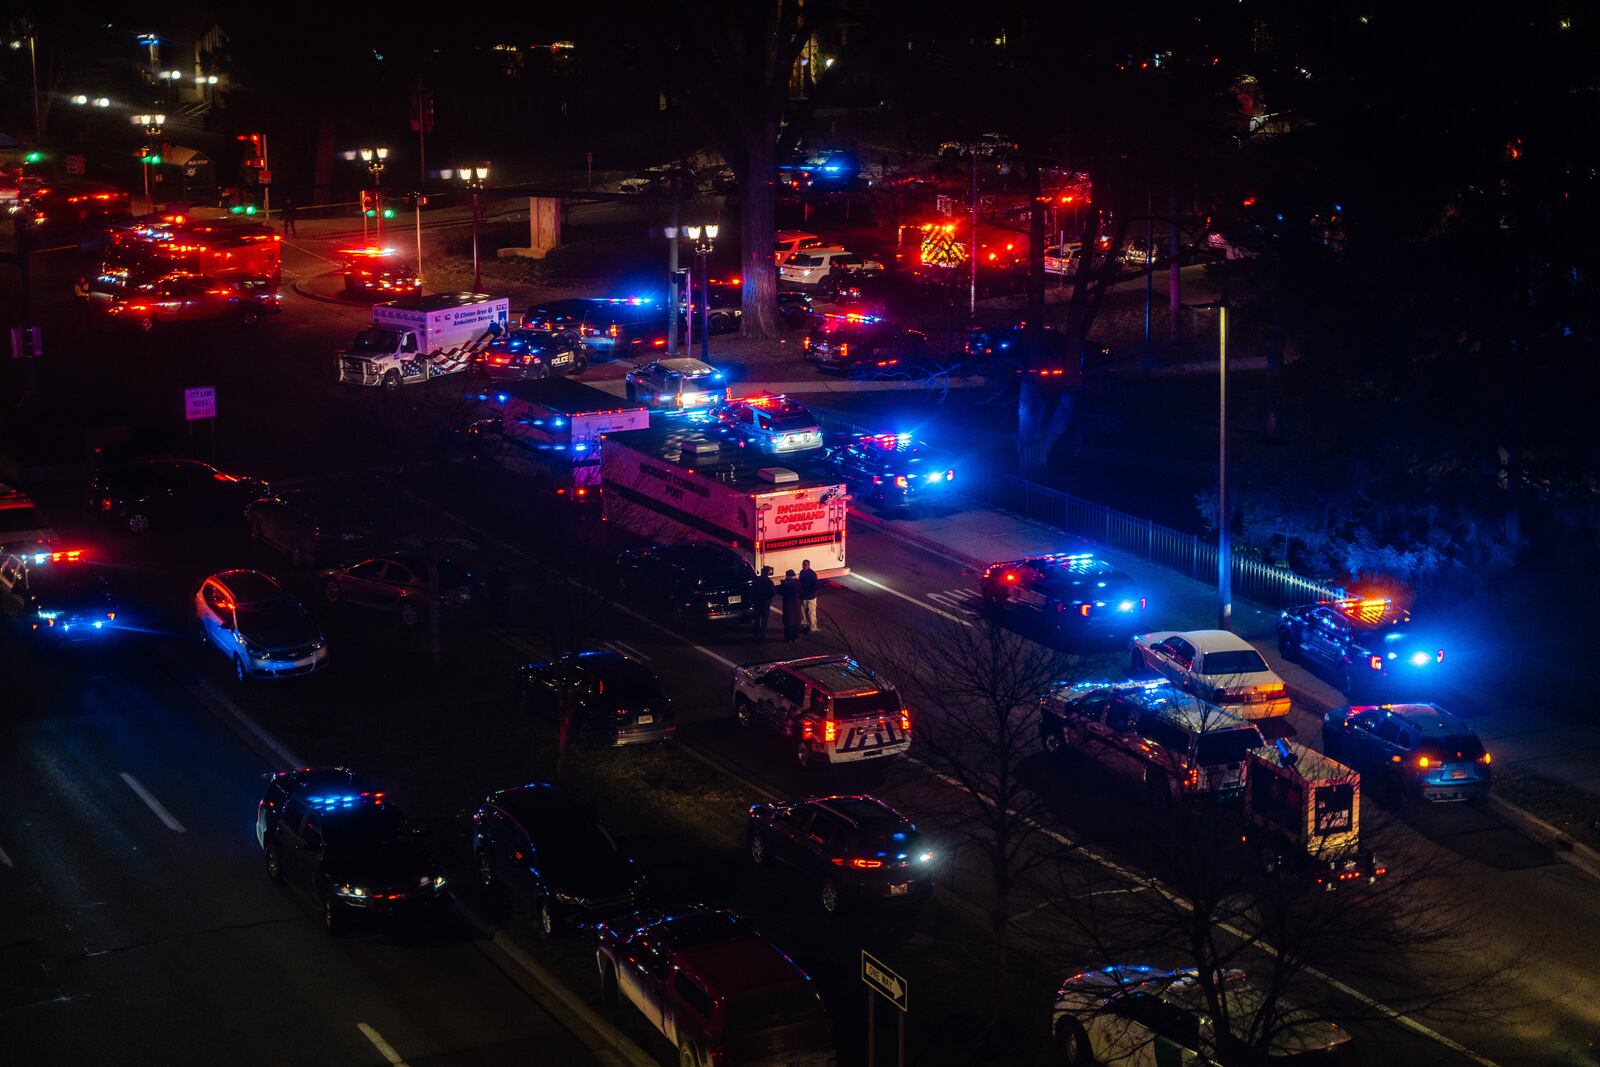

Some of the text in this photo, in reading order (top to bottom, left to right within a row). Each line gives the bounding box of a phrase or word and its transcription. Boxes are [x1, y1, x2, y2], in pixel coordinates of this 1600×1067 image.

[551, 355, 569, 366] POLICE
[193, 399, 208, 407] MUST
[665, 484, 684, 501] POST
[673, 475, 711, 498] COMMAND
[777, 501, 825, 514] INCIDENT
[775, 510, 826, 524] COMMAND
[787, 522, 813, 533] POST
[766, 535, 834, 549] EMERGENCY MANAGEMENT
[868, 966, 893, 989] ONE WAY
